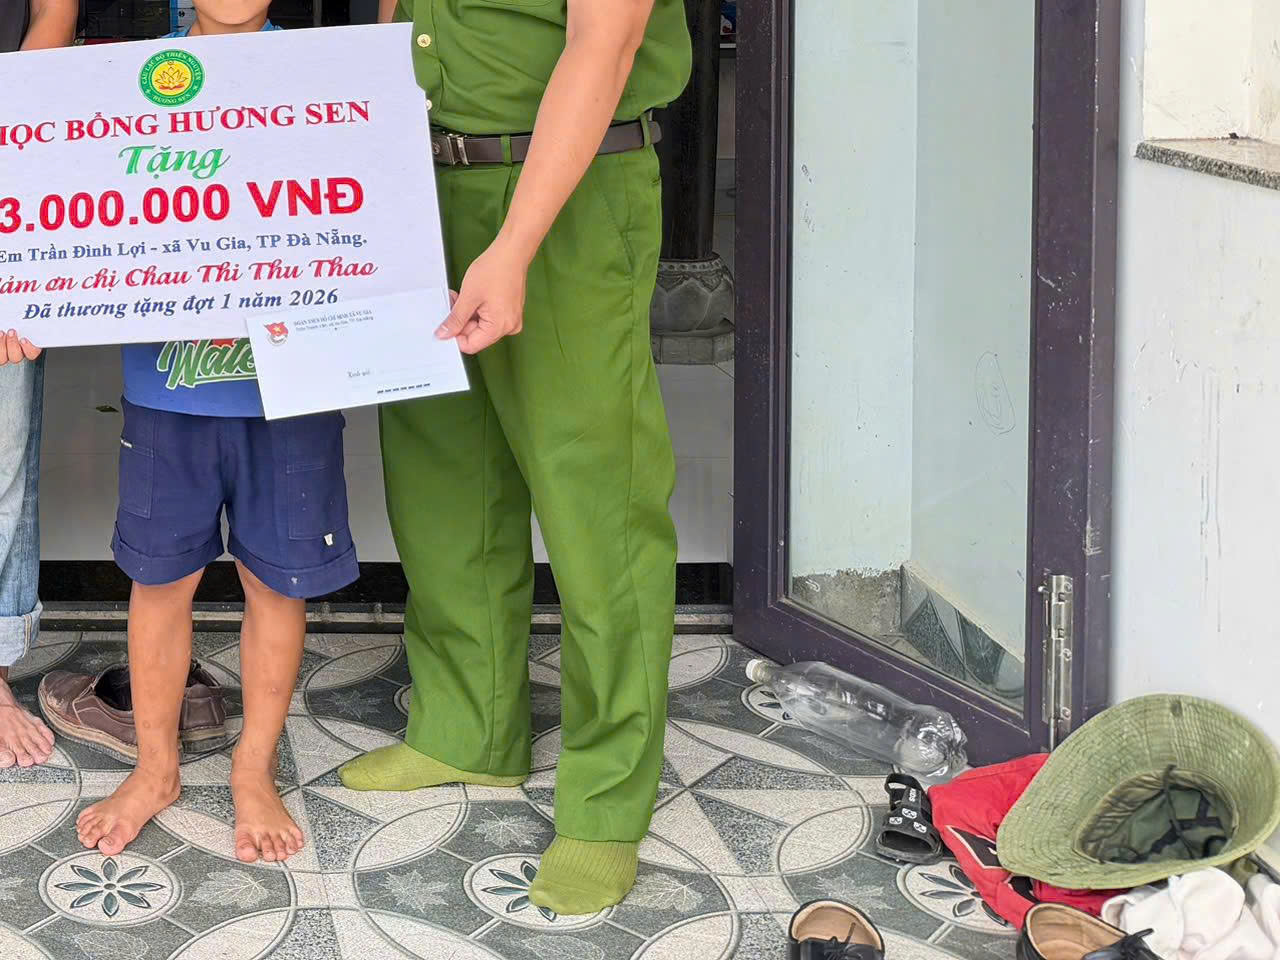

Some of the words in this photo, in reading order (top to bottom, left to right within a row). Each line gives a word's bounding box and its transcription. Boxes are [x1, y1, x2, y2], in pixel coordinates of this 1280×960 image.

[64, 112, 160, 142] BỔNG
[168, 104, 296, 134] HƯƠNG
[305, 100, 370, 125] SEN
[118, 144, 231, 180] Tặng
[246, 176, 364, 218] VNĐ
[27, 243, 68, 261] Trần
[72, 243, 113, 259] Đình
[117, 241, 146, 258] Lợi
[162, 238, 182, 254] xã
[186, 238, 211, 252] Vu
[216, 236, 252, 252] Gia,
[256, 234, 281, 249] TP
[286, 232, 312, 248] Đà
[316, 228, 367, 248] Nẵng.
[45, 276, 78, 291] ơn
[81, 267, 120, 292] chị
[125, 265, 192, 288] Chau
[197, 261, 243, 284] Thi
[248, 258, 303, 281] Thu
[308, 256, 379, 279] Thao
[22, 302, 52, 320] Đã
[57, 301, 128, 319] thương
[133, 297, 177, 317] tặng
[182, 294, 215, 315] đợt
[221, 293, 232, 310] 1
[238, 291, 282, 309] năm
[289, 288, 339, 307] 2026
